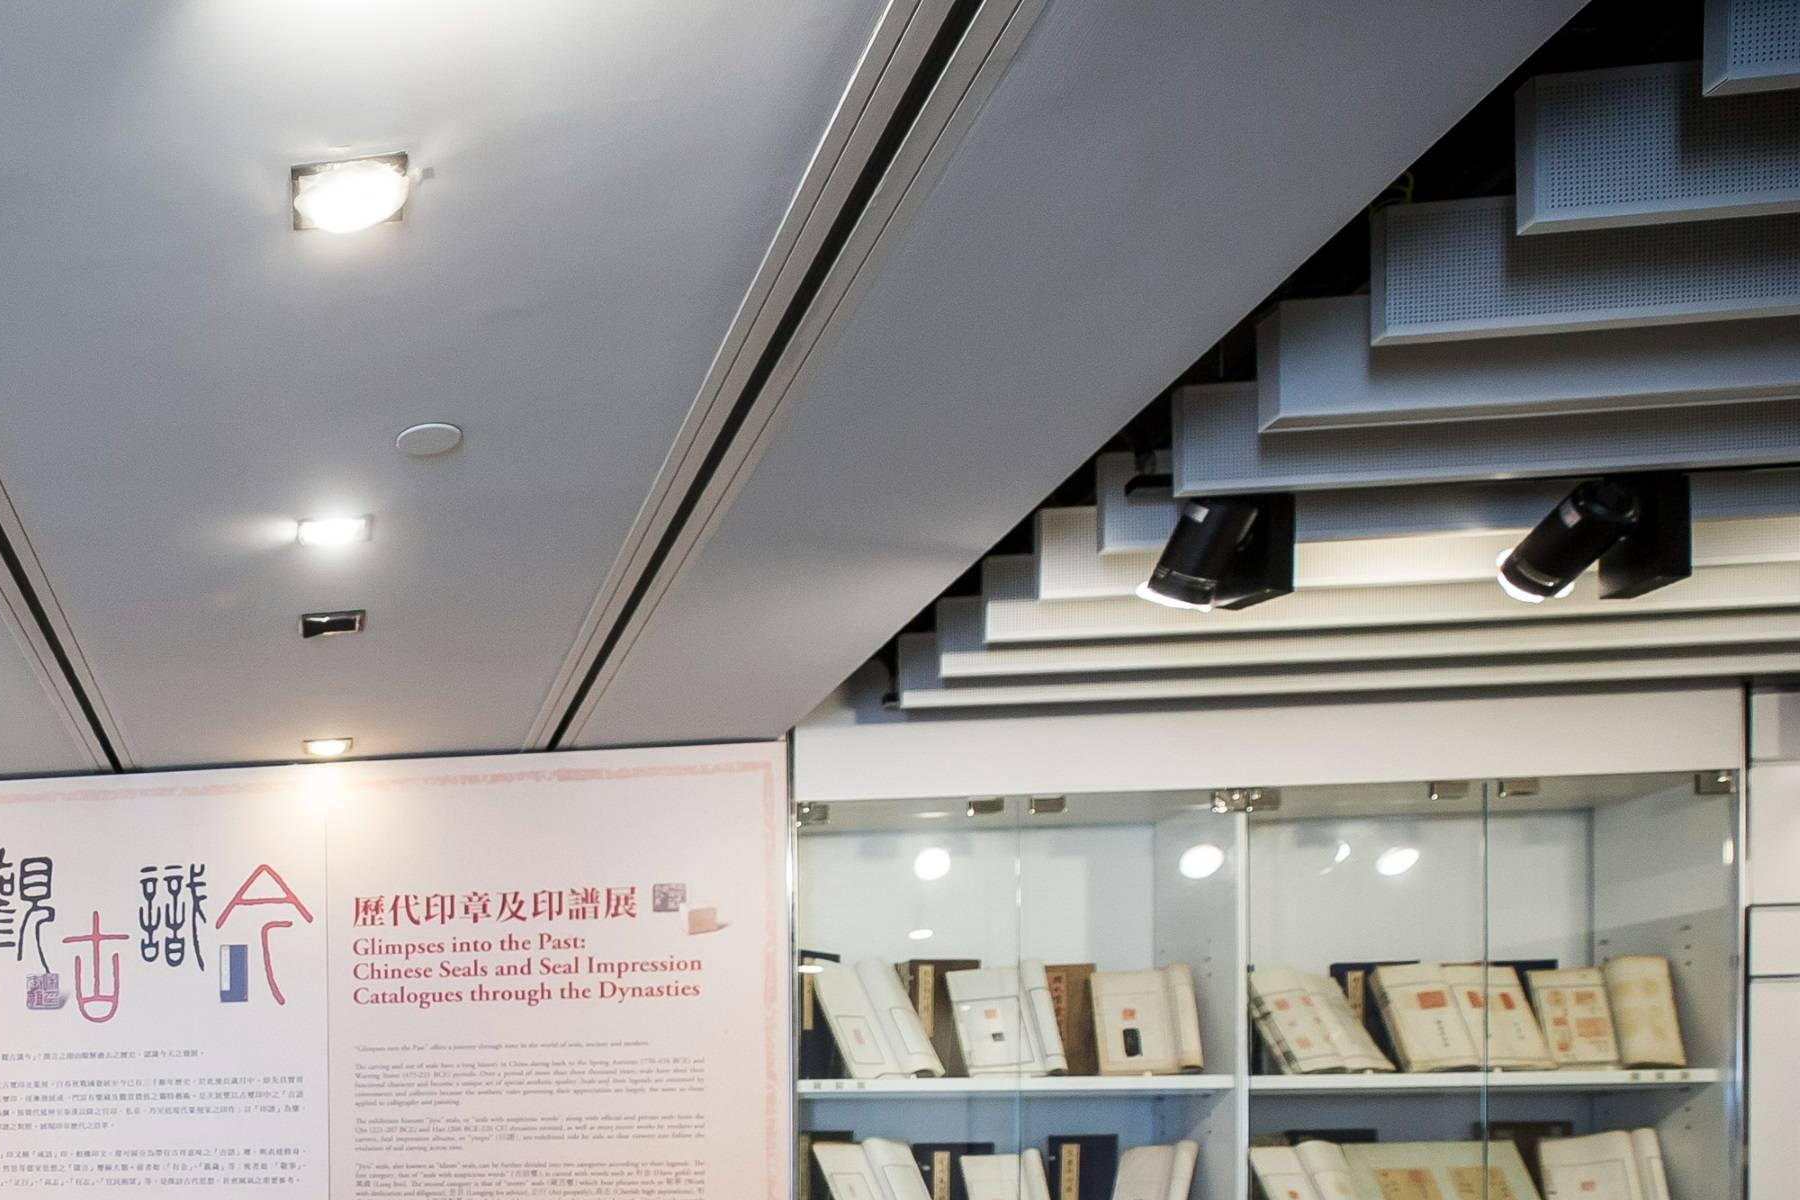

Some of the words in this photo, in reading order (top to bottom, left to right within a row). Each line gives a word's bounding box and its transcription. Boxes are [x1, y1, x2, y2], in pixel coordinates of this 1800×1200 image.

[352, 886, 638, 928] 歷代印章及印譜展
[353, 937, 445, 960] Glimpses
[452, 936, 493, 953] into
[499, 934, 531, 951] the
[538, 932, 586, 950] Past:
[353, 962, 433, 980] Chinese
[439, 959, 488, 979] Seals
[495, 958, 532, 977] and
[539, 956, 580, 975] Seal
[587, 955, 703, 978] Impression
[353, 985, 463, 1009] Catalogues
[470, 983, 552, 1006] through
[559, 982, 592, 999] the
[599, 980, 701, 1003] Dynasties
